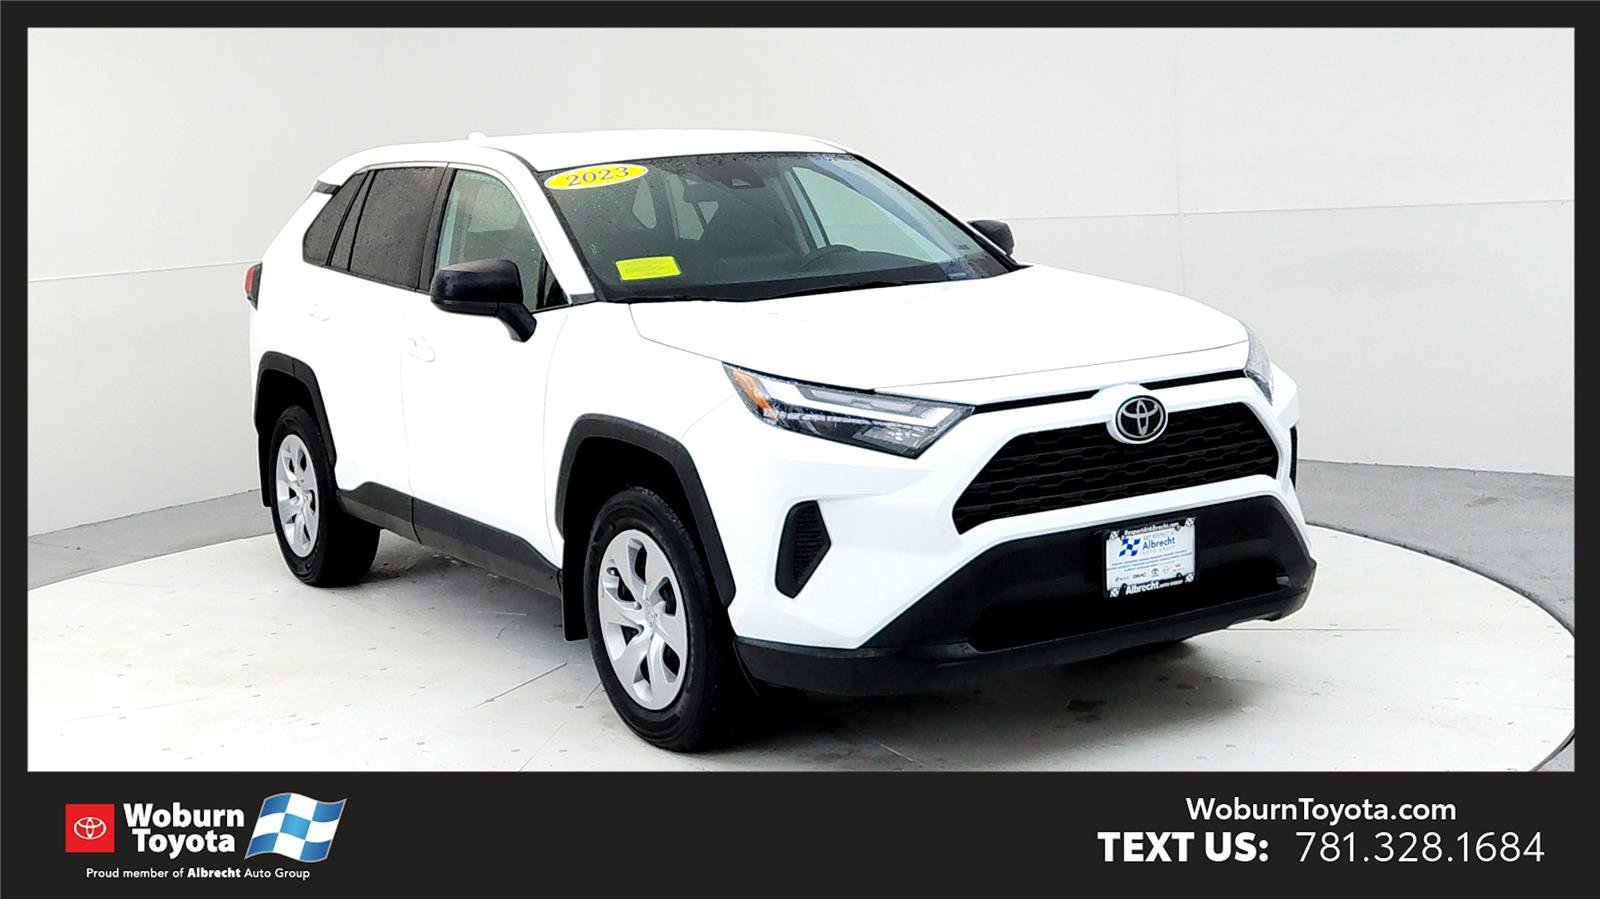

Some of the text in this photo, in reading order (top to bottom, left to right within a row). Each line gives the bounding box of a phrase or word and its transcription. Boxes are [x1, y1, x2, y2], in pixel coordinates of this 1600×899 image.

[566, 167, 629, 186] 2023
[1142, 536, 1175, 550] Albrecht
[1125, 581, 1159, 595] Albrecht
